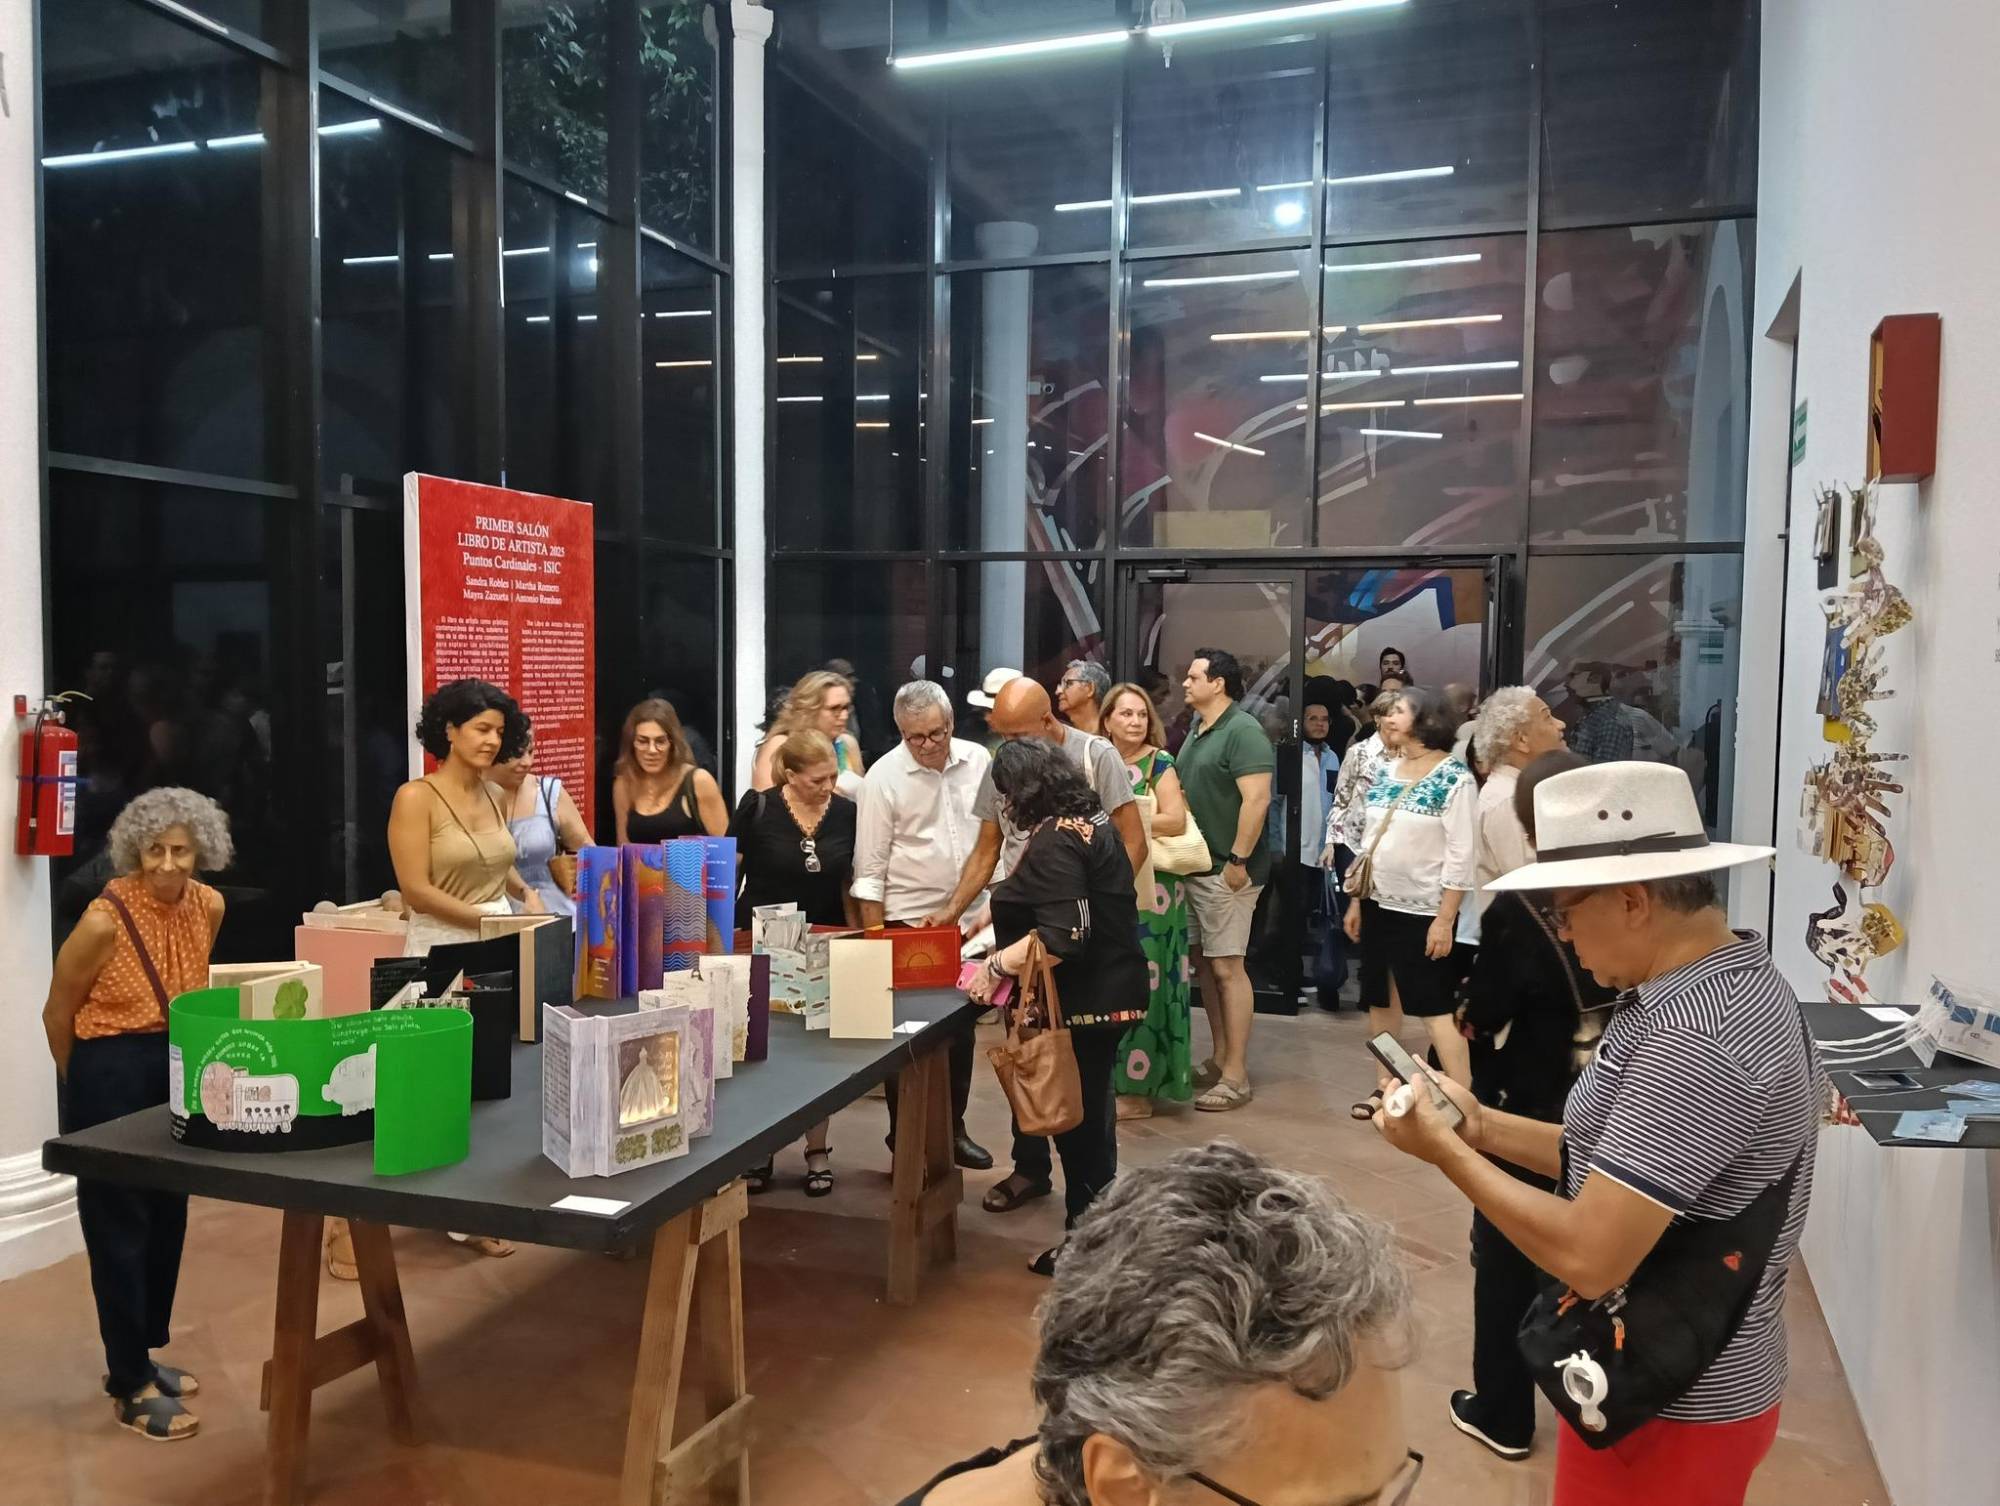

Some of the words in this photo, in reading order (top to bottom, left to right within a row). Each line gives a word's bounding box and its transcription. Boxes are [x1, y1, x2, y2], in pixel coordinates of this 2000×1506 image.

[475, 516, 515, 533] PRIMER
[516, 522, 549, 538] SALÓN
[458, 532, 489, 548] LIBRO
[492, 536, 506, 551] DE
[508, 539, 548, 556] ARTISTA
[549, 546, 565, 557] 2025
[463, 552, 492, 568] Puntos
[494, 556, 536, 572] Cardinales
[544, 560, 561, 574] ISIC
[466, 576, 488, 587] Sandra
[489, 577, 509, 588] Robles
[515, 580, 536, 590] Martha
[464, 589, 483, 601] Mayra
[485, 590, 509, 602] Zazueta
[515, 593, 538, 604] Antonio
